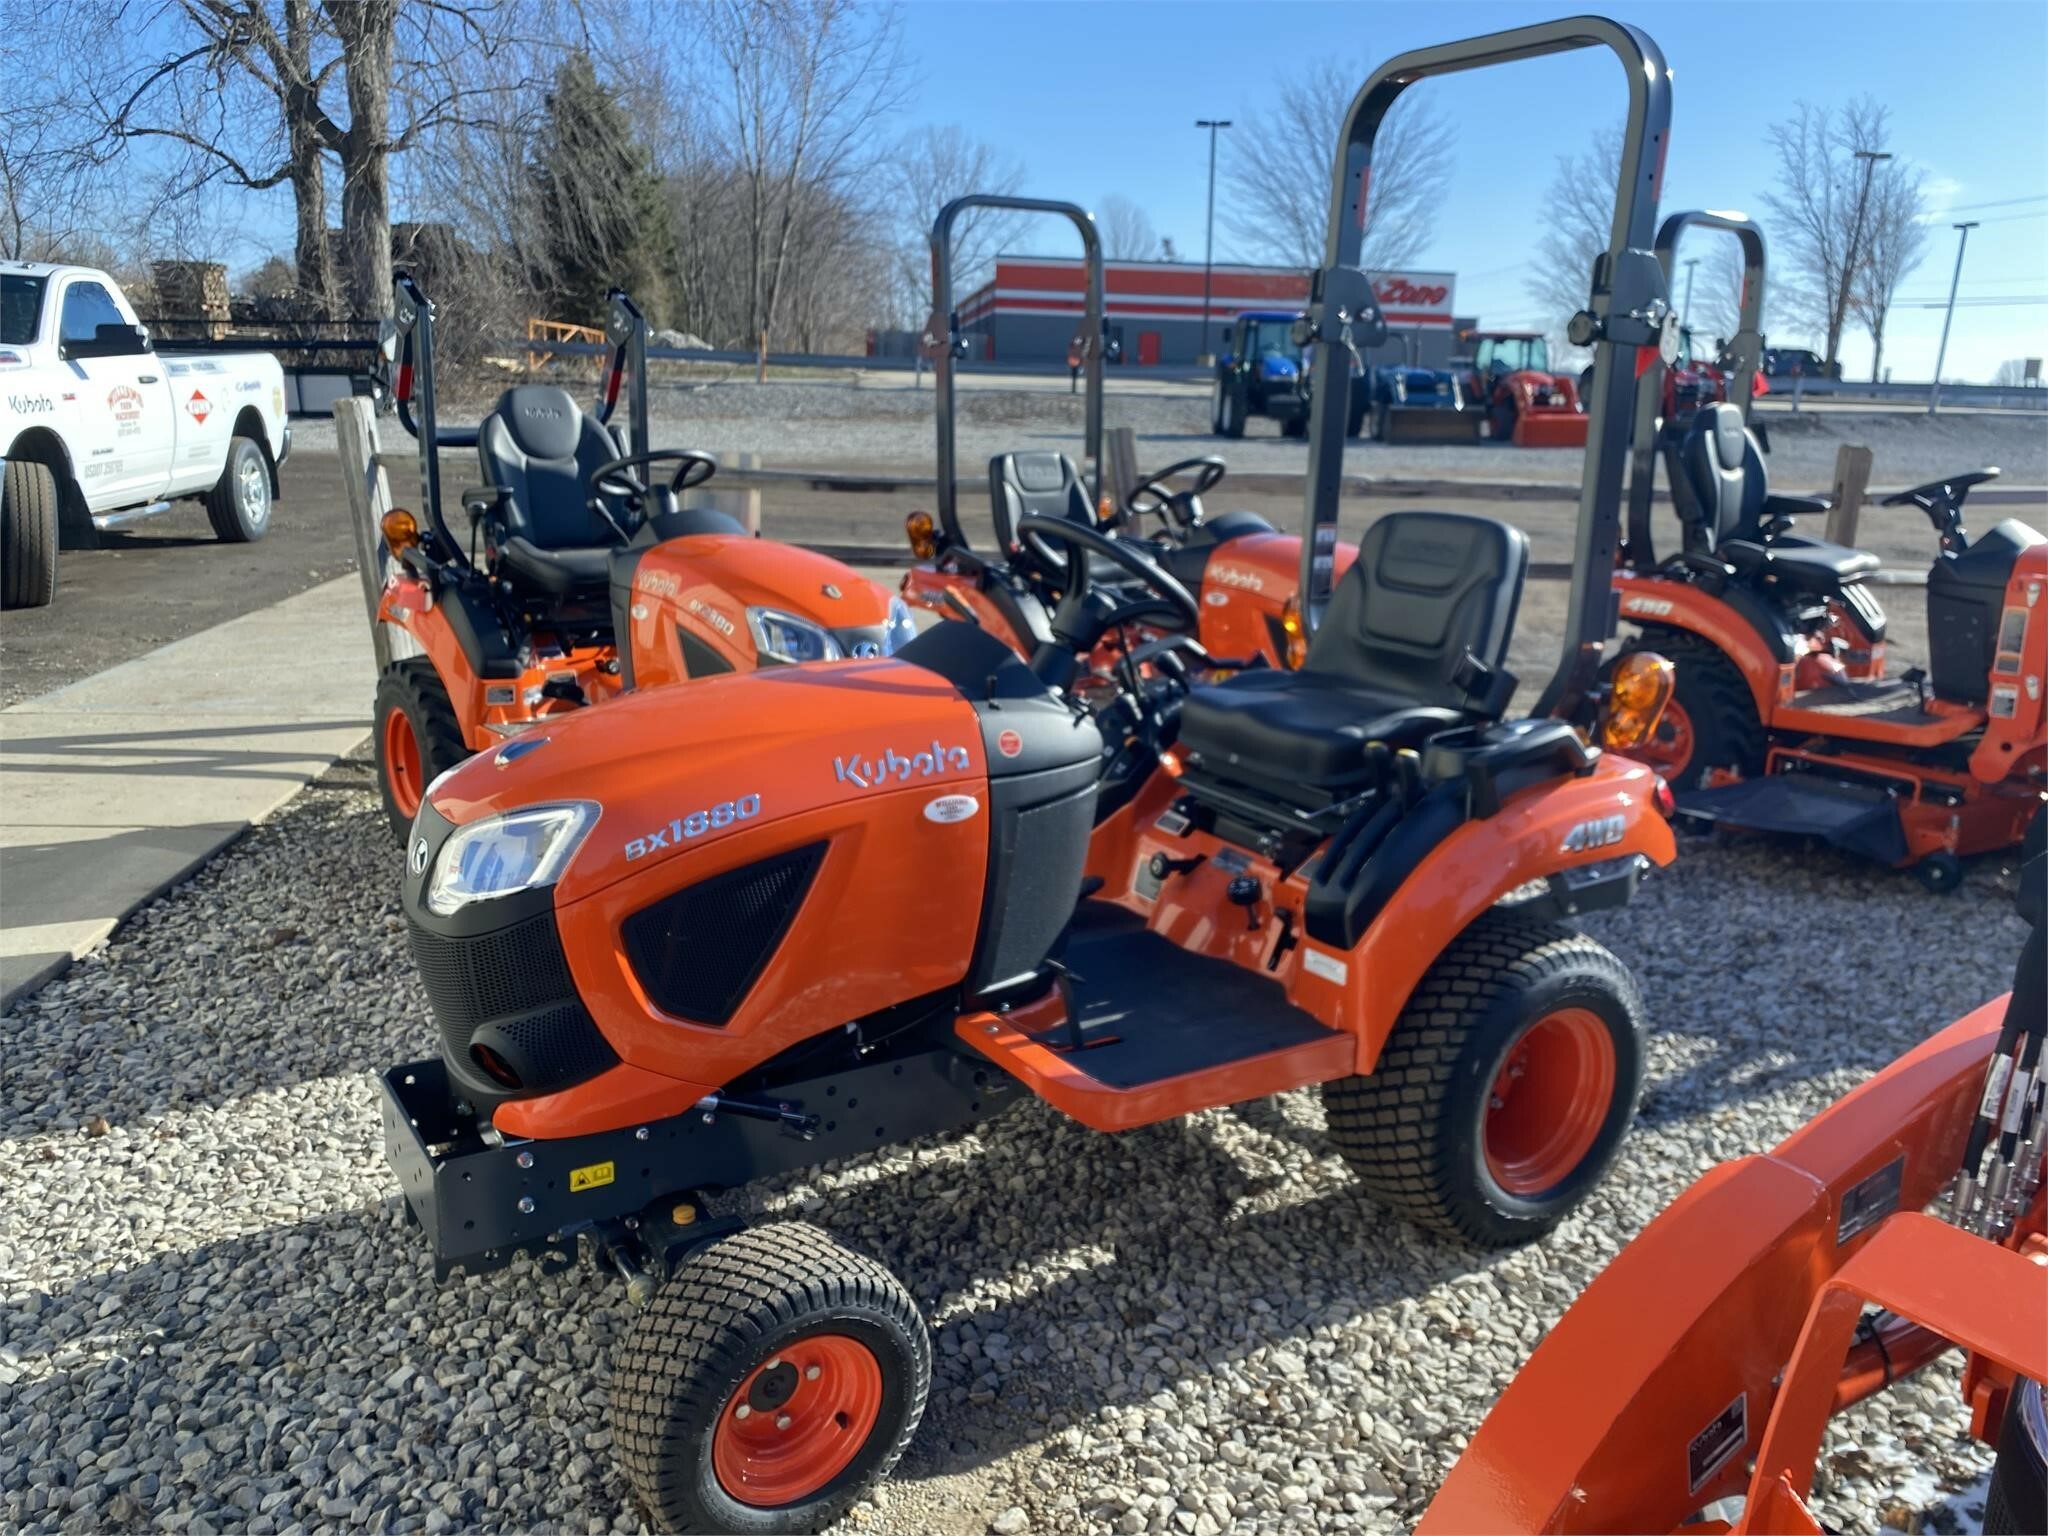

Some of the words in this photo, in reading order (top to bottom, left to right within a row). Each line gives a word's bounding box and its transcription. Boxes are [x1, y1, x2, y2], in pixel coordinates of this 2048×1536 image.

[8, 393, 54, 414] Kubota
[1209, 563, 1263, 592] Kubota
[834, 740, 971, 788] Kubota
[624, 793, 761, 862] BX1880
[1560, 814, 1626, 852] 4WD
